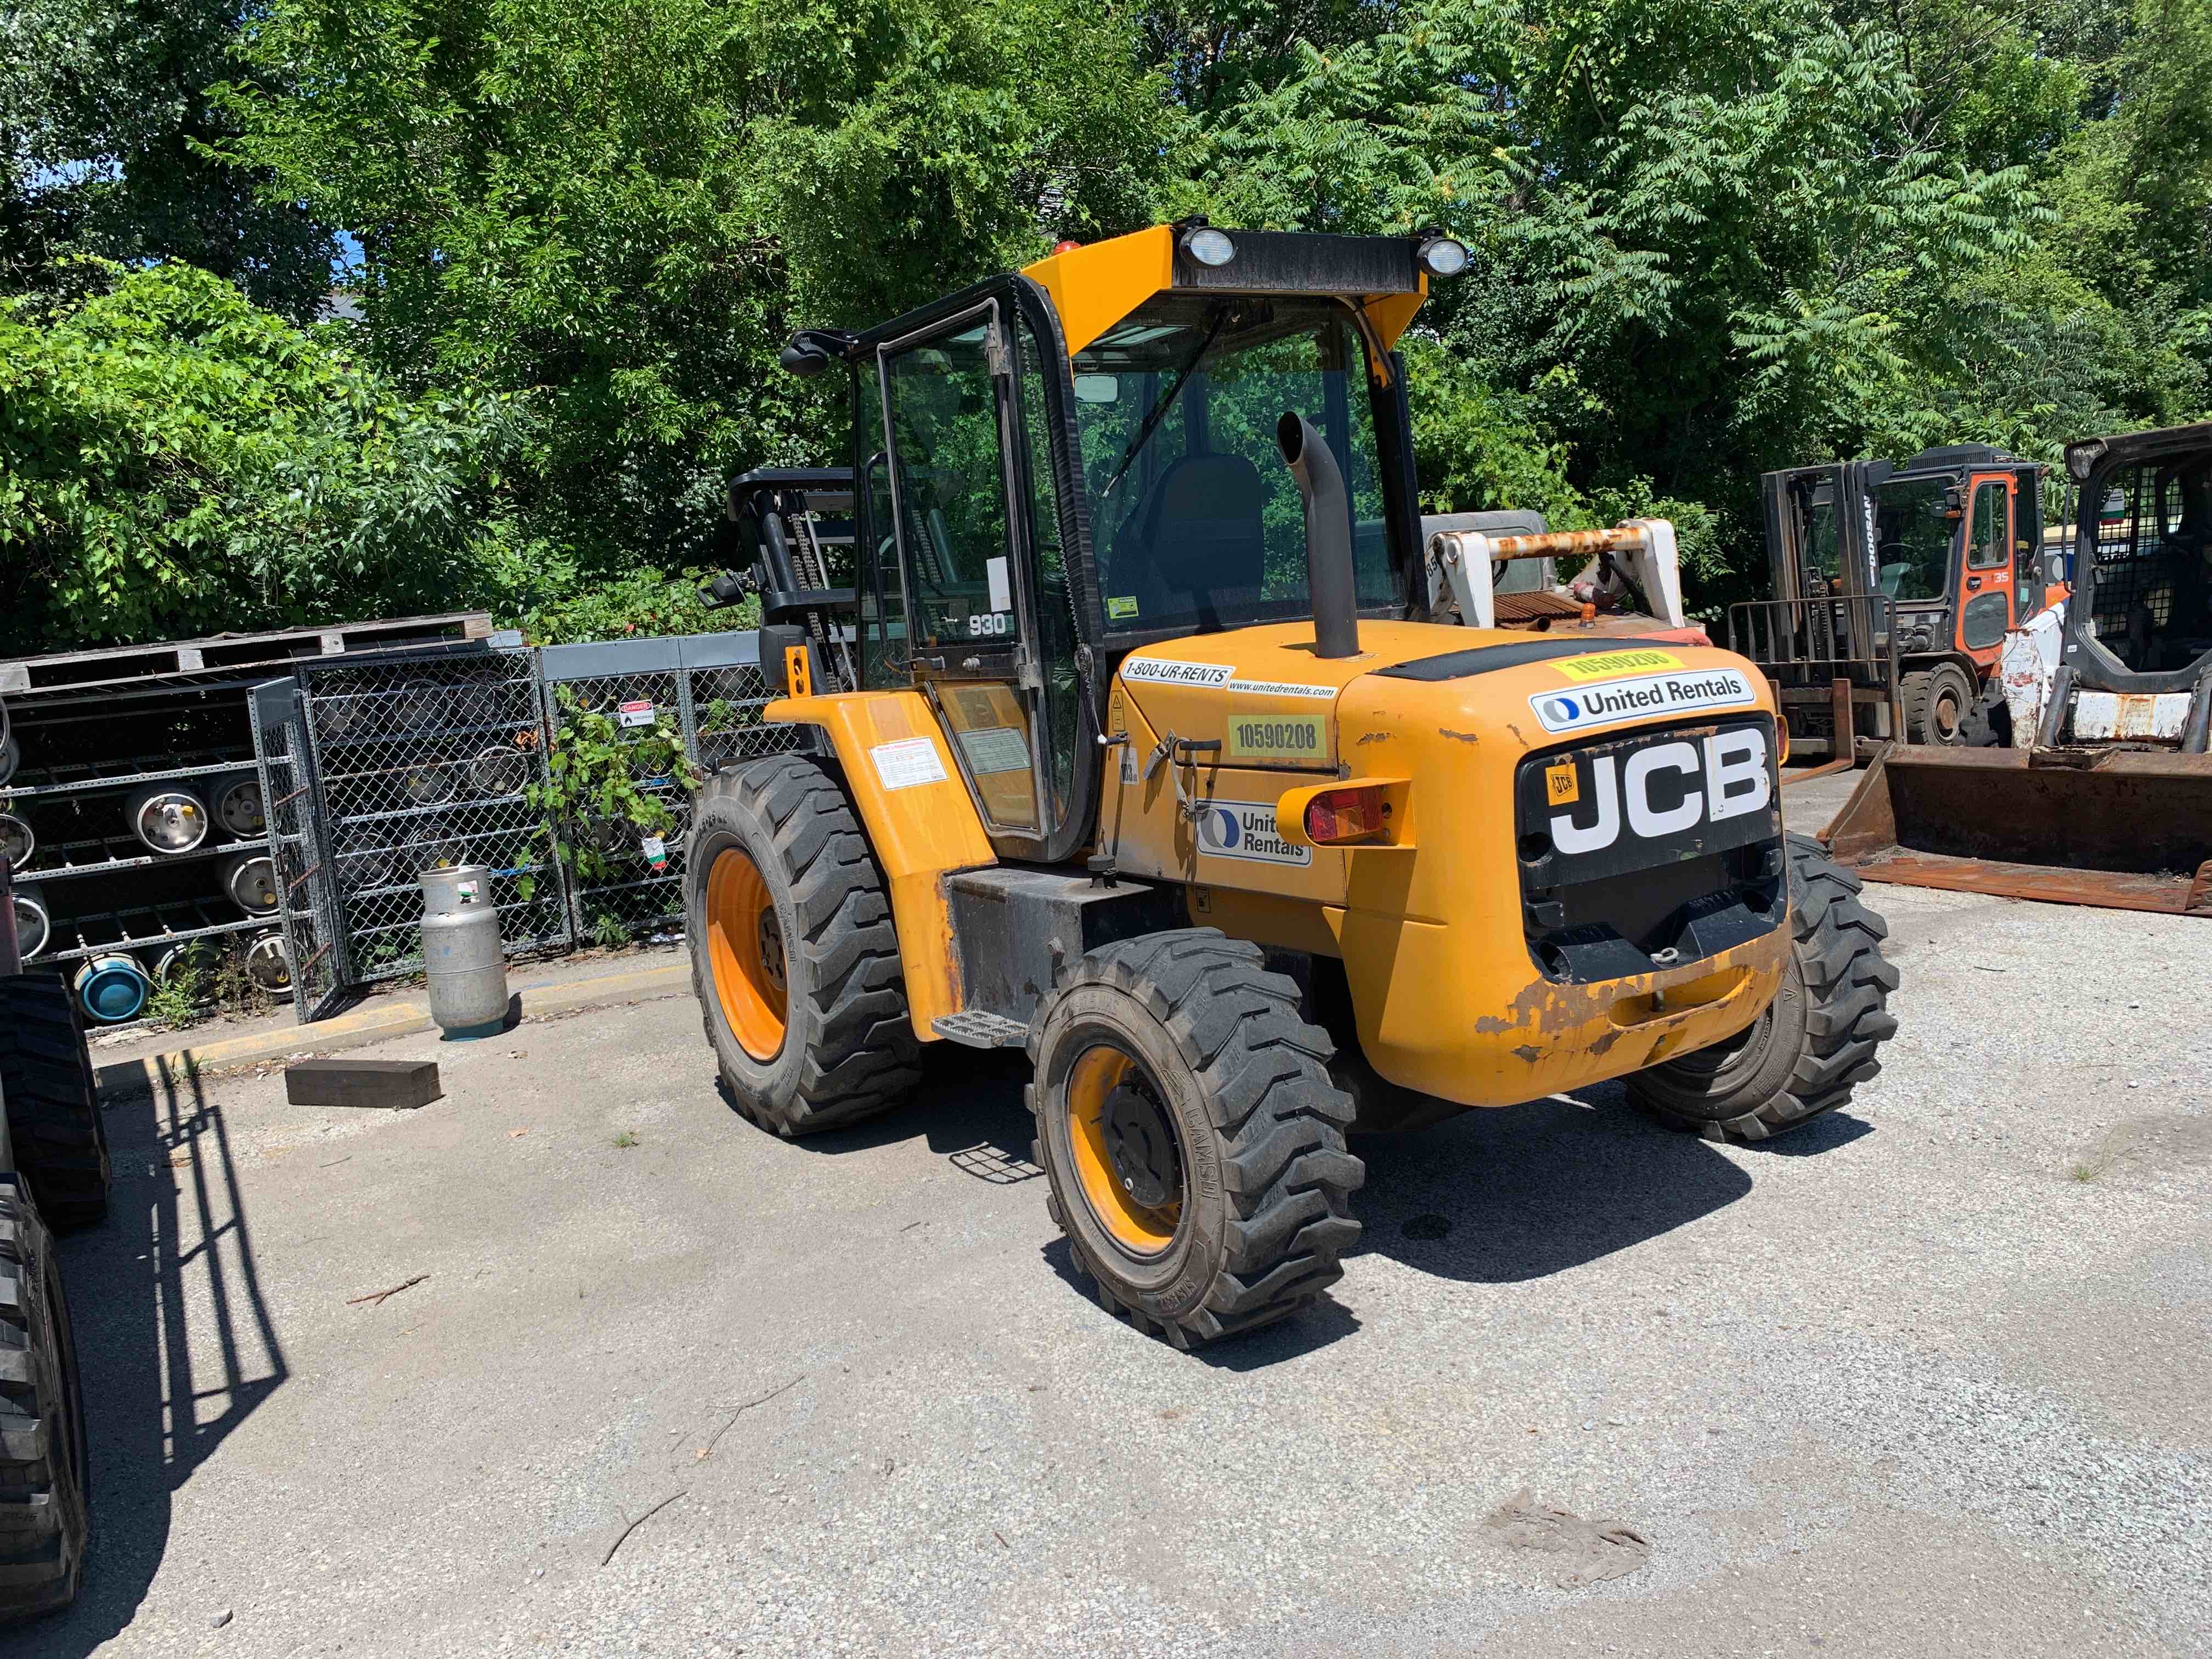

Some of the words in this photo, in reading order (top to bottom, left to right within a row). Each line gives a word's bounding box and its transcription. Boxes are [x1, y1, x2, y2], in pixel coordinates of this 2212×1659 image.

[1864, 495, 1876, 567] DOOSAN
[1994, 572, 2009, 583] 35
[969, 613, 1006, 636] 930
[1126, 662, 1228, 683] 1-800-UR-RENTS
[1566, 652, 1669, 674] 10590208
[1229, 681, 1335, 697] www.unitedrentals.com
[1582, 684, 1664, 715] United
[1666, 675, 1742, 702] Rentals
[1237, 724, 1317, 749] 10590208
[1550, 728, 1770, 855] JCB
[1555, 776, 1572, 794] JCB
[1243, 812, 1277, 833] Unit
[1185, 1106, 1220, 1200] CAMSO
